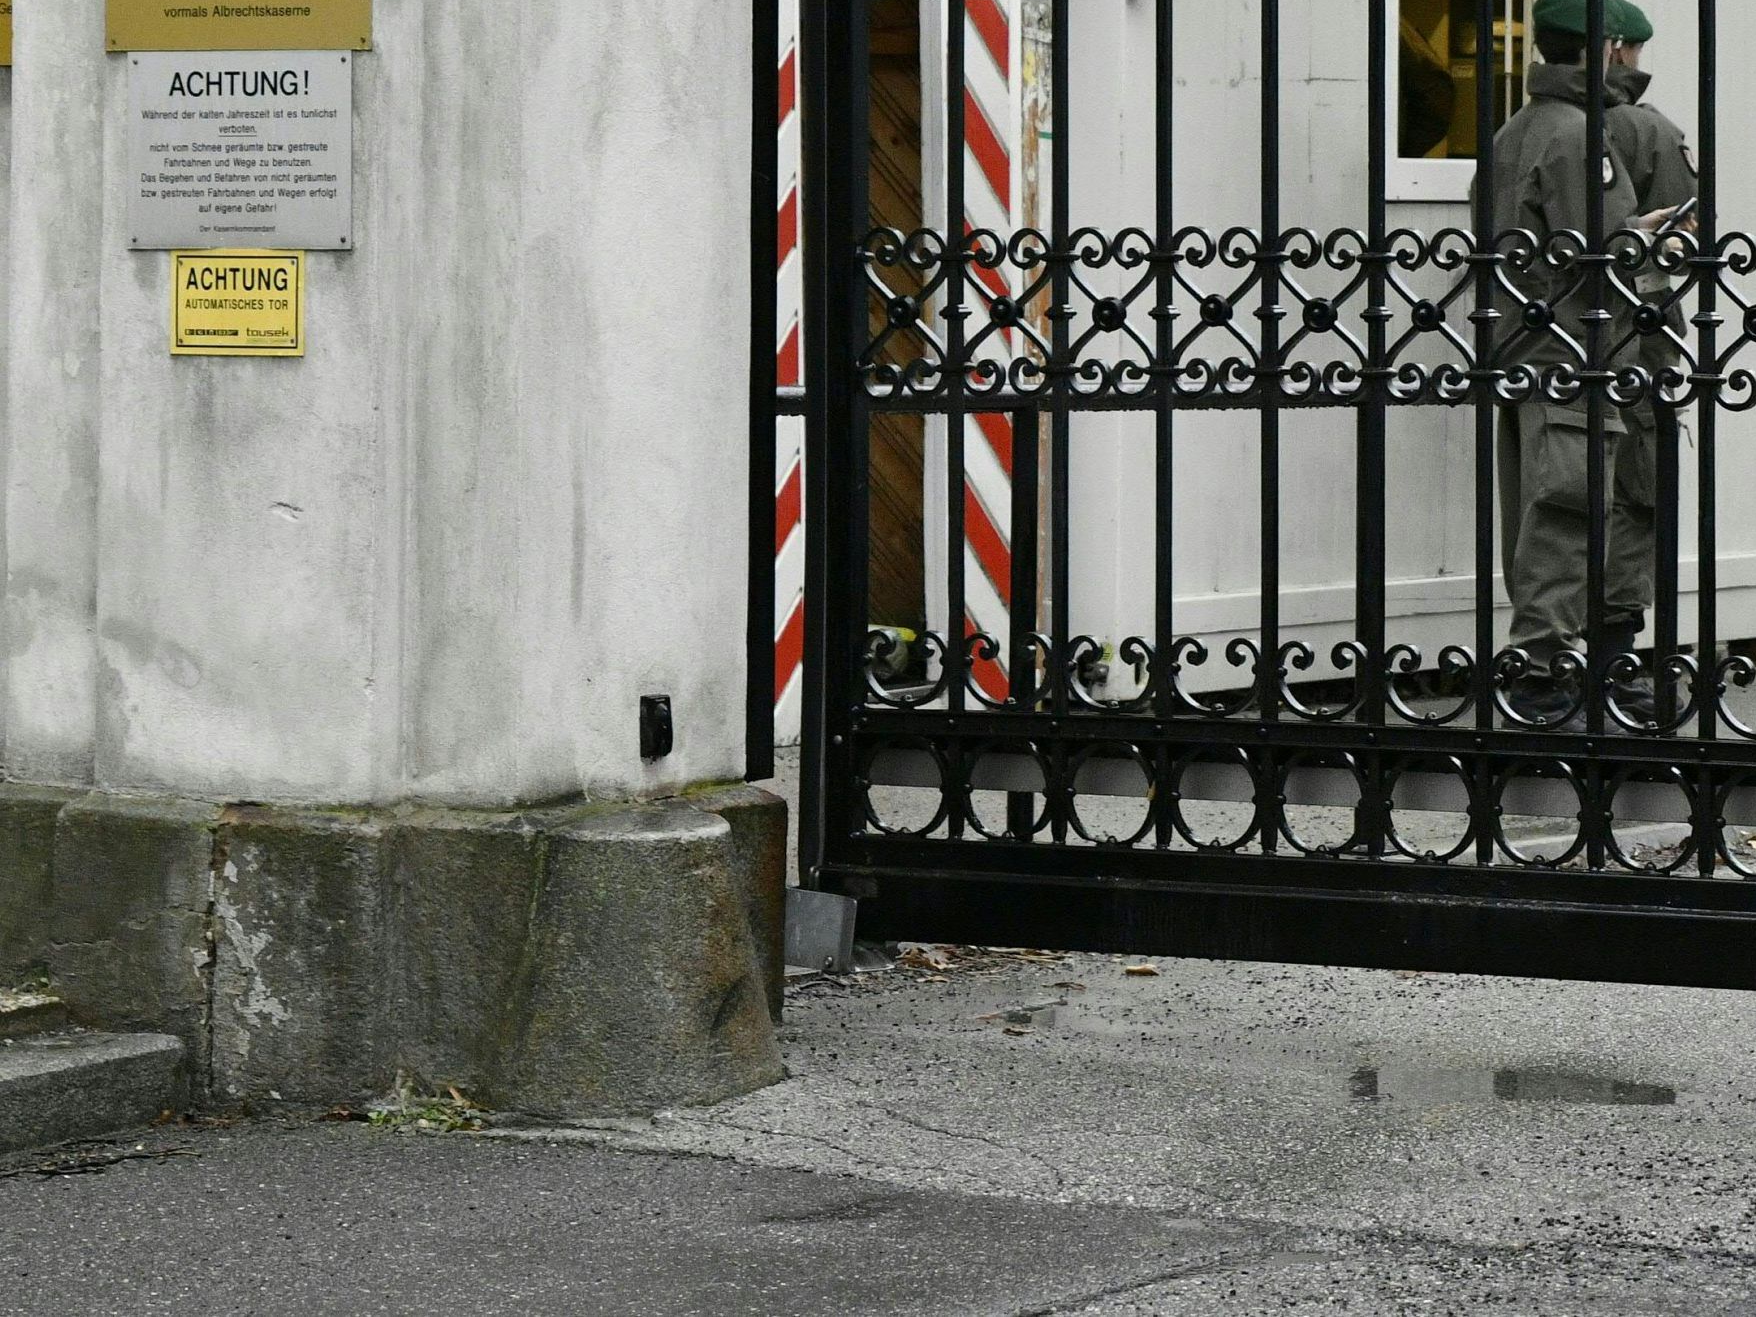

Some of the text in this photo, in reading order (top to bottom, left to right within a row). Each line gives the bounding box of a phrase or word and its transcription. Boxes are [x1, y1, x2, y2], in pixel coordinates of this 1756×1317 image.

[164, 5, 311, 18] vormals Albrechtskaserne
[169, 70, 310, 97] ACHTUNG!
[182, 110, 196, 120] der
[199, 109, 224, 120] kalten
[226, 109, 270, 119] Jahreszeit
[273, 109, 284, 119] ist
[287, 111, 298, 119] es
[301, 109, 337, 119] tunlichst
[150, 143, 169, 153] nicht
[172, 144, 189, 152] vom
[192, 142, 222, 152] Schnee
[288, 142, 328, 154] gestreute
[164, 158, 211, 168] Fahrbahnen
[215, 158, 230, 167] und
[233, 157, 256, 169] Wege
[259, 159, 269, 167] zu
[141, 173, 156, 183] Das
[159, 173, 194, 184] Begehen
[197, 173, 212, 183] und
[215, 173, 250, 183] Befahren
[254, 174, 268, 182] von
[271, 172, 290, 182] nicht
[161, 189, 205, 200] gestreuten
[208, 188, 256, 198] Fahrbahnen
[259, 188, 274, 198] und
[277, 188, 307, 199] Wegen
[309, 188, 337, 199] erfolgt
[199, 203, 277, 215] auf eigene Gefahr!
[186, 267, 288, 291] ACHTUNG
[185, 299, 289, 310] AUTOMATISCHES TOR
